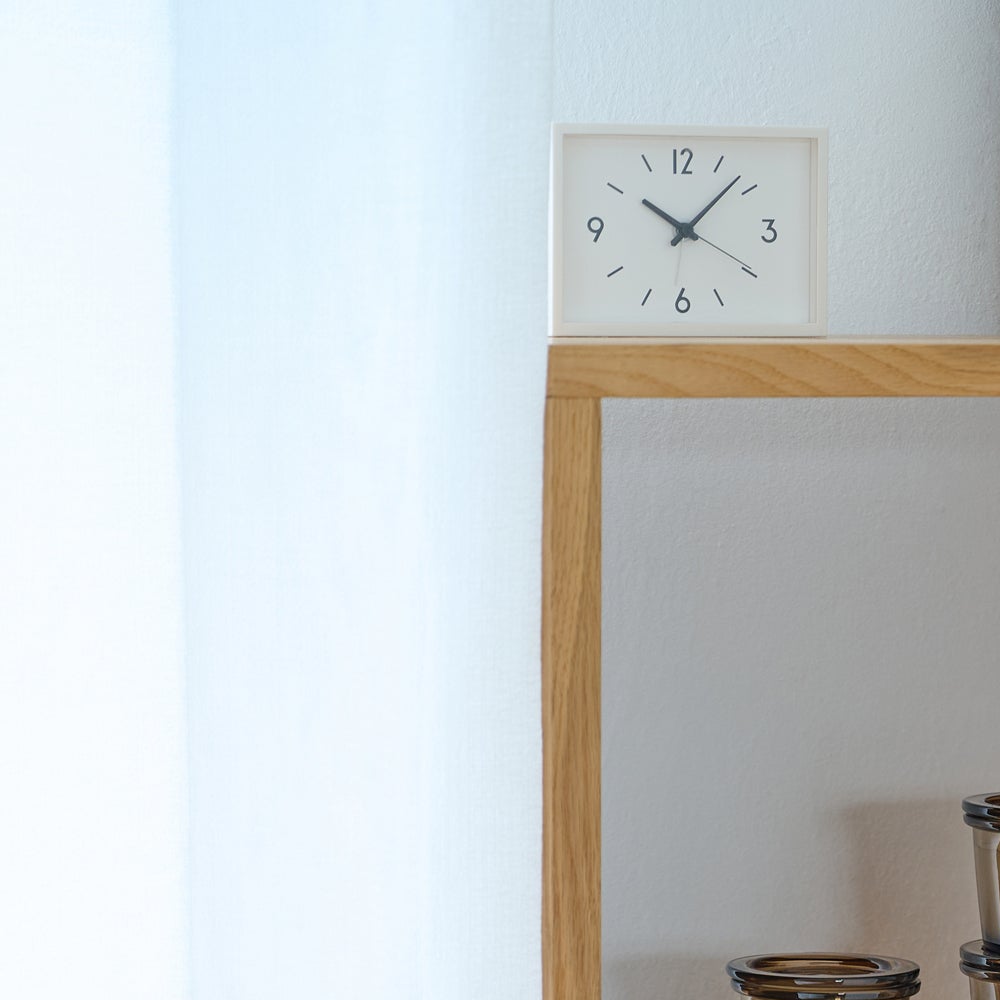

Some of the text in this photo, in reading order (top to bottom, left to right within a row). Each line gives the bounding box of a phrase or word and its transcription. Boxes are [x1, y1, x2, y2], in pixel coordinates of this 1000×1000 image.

[672, 148, 693, 174] 12
[587, 217, 604, 242] 9
[761, 219, 778, 243] 3
[675, 288, 691, 313] 6
